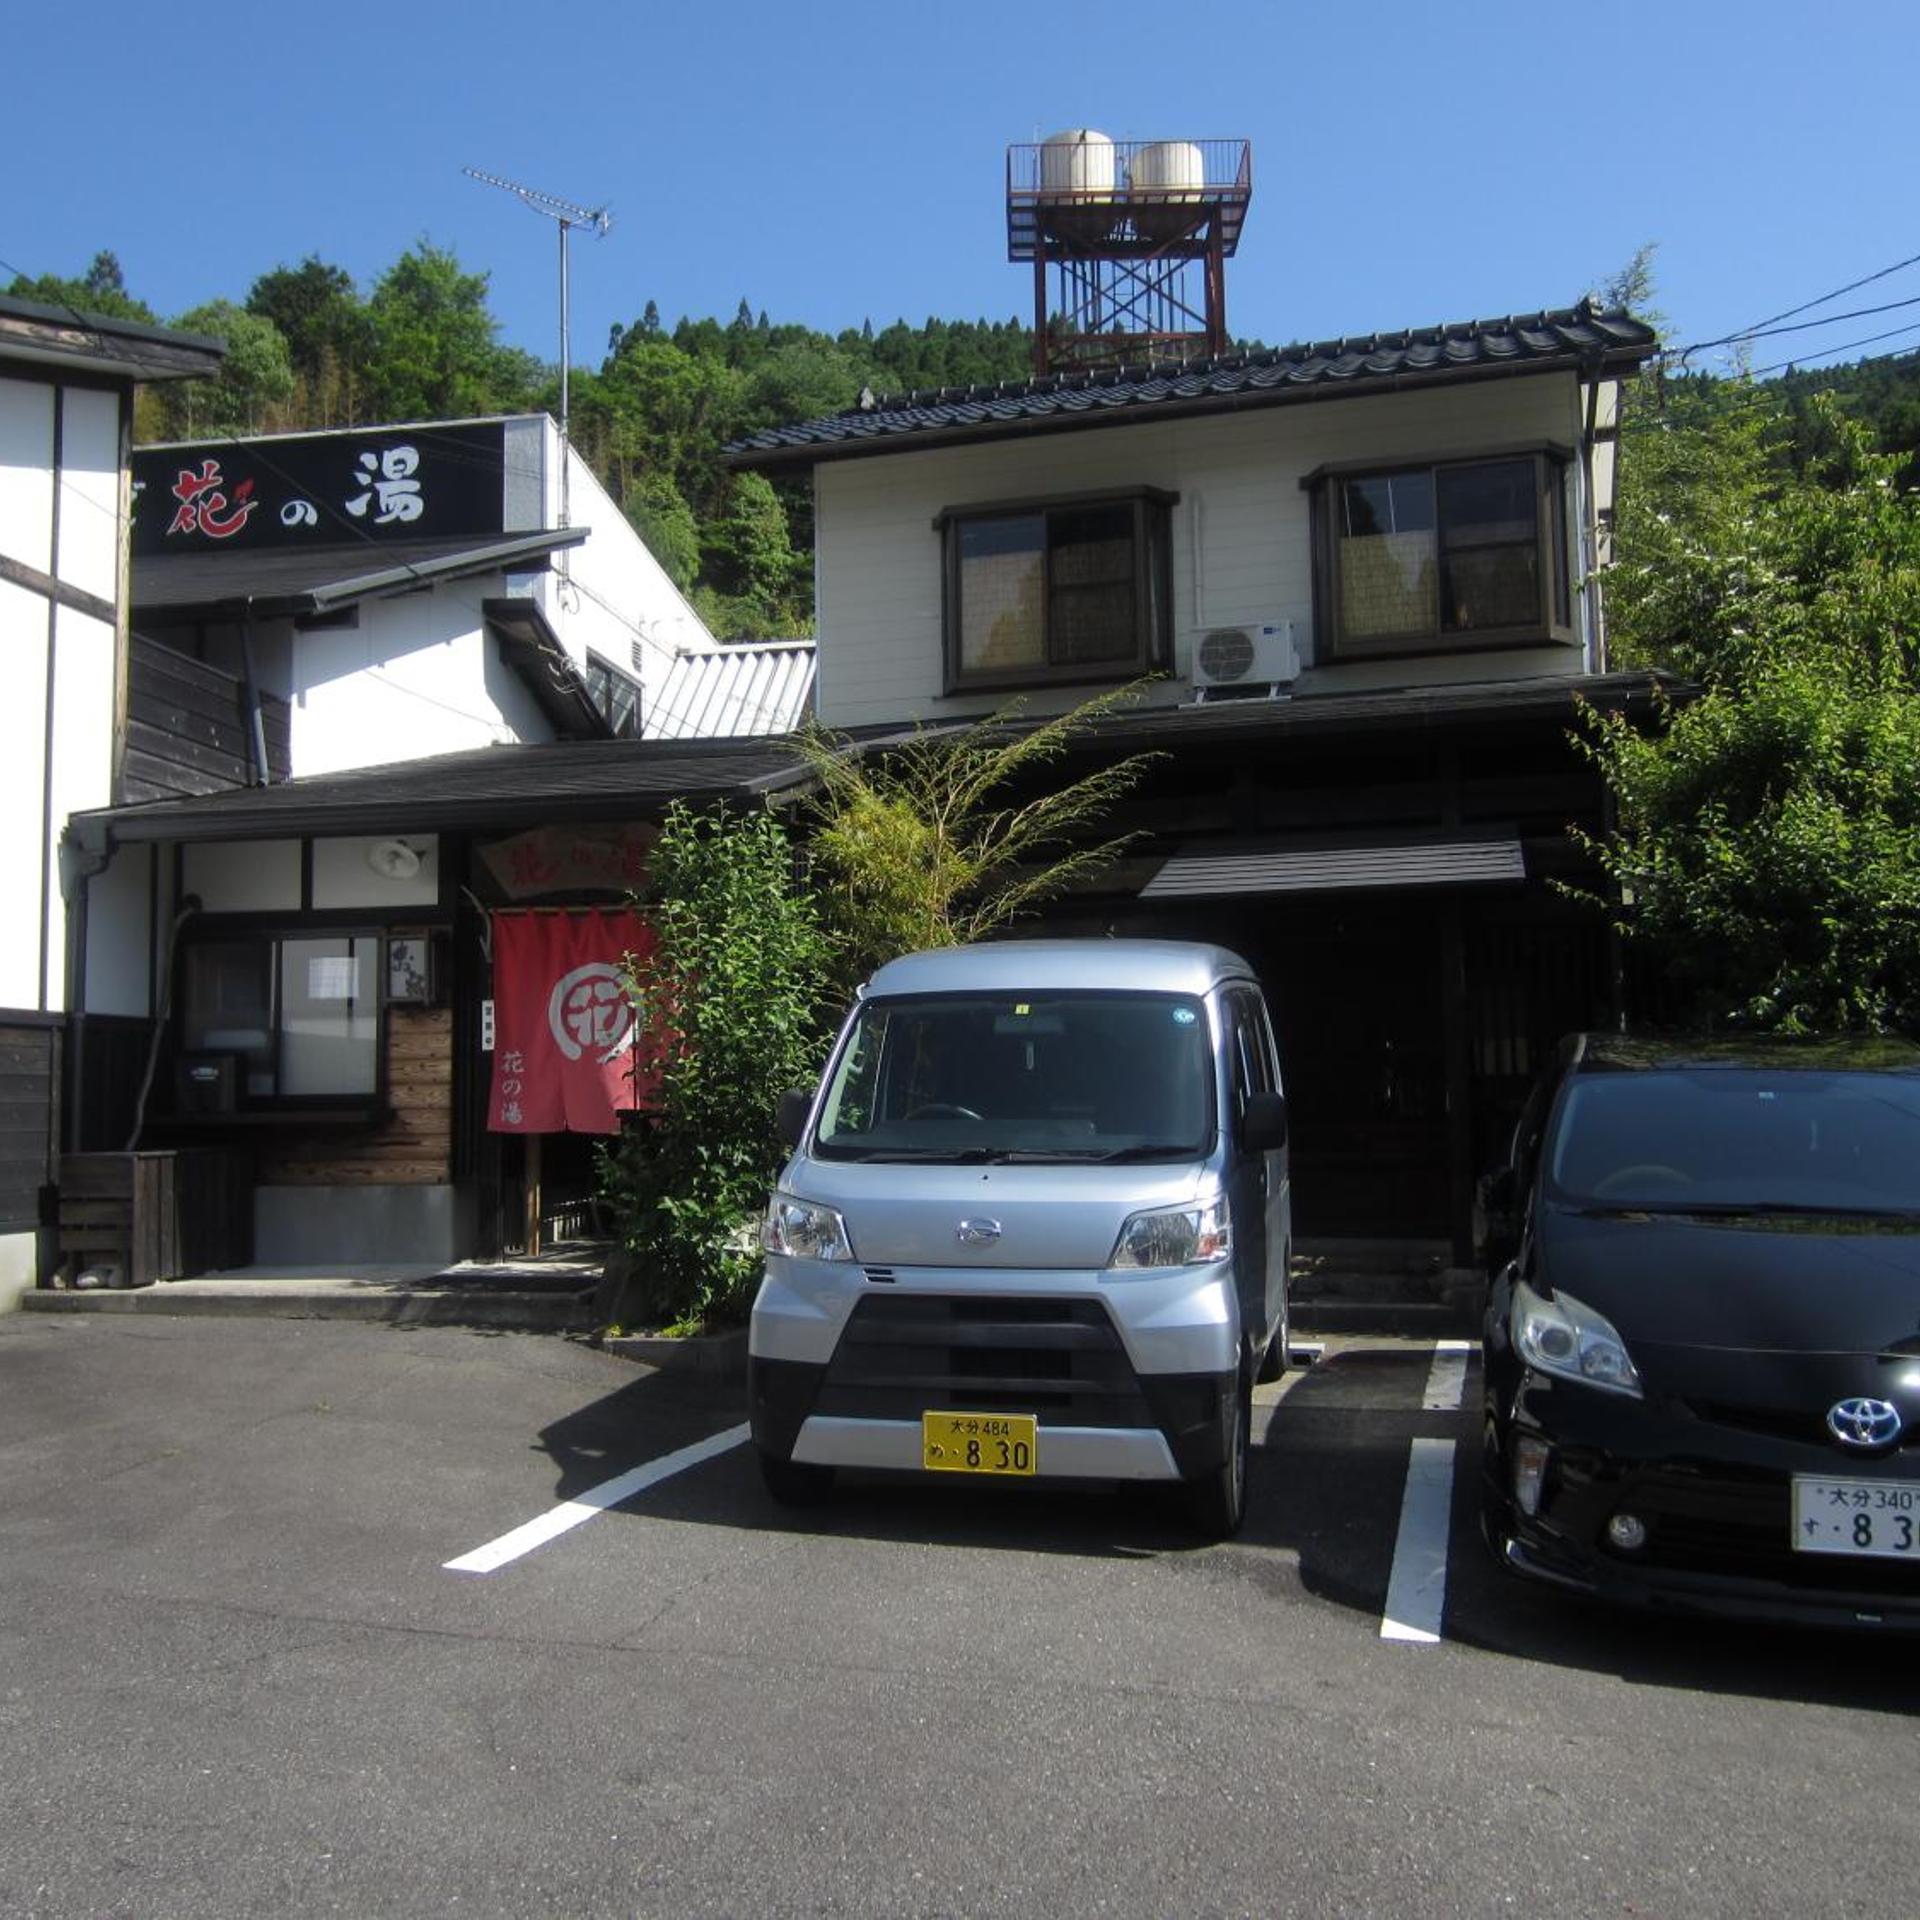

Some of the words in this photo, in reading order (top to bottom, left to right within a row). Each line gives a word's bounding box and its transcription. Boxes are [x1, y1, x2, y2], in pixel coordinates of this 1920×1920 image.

[167, 446, 425, 538] 花の湯
[501, 1051, 525, 1125] 花の湯
